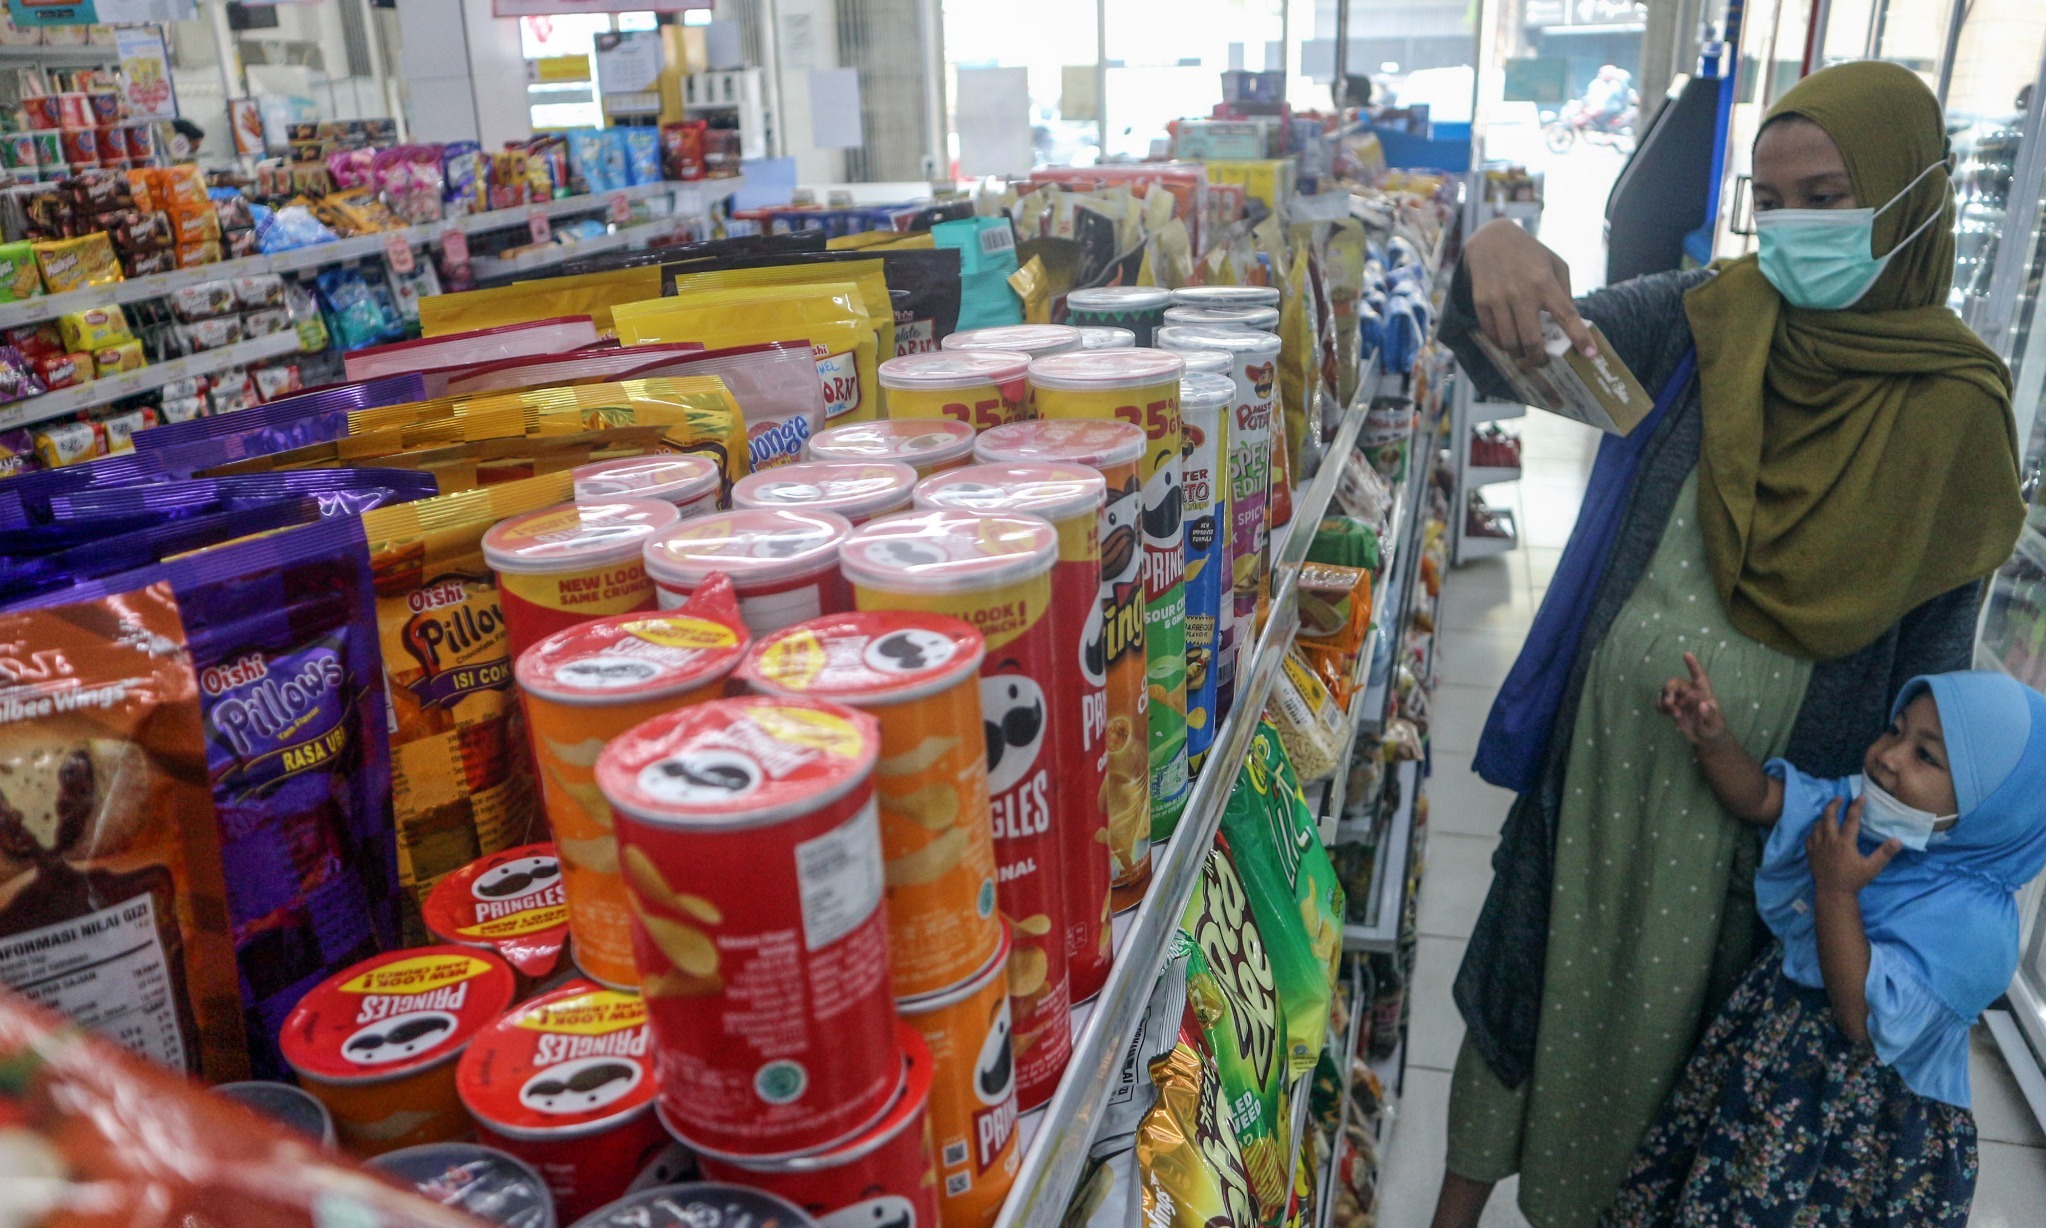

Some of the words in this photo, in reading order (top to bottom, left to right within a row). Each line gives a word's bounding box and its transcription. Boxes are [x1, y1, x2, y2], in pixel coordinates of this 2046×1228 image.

[1236, 404, 1271, 431] POTA
[1230, 440, 1268, 478] SPEC
[1182, 469, 1208, 482] TER
[1232, 471, 1266, 503] EDIT
[558, 575, 601, 594] NEW
[1143, 550, 1185, 593] PRING
[408, 582, 464, 613] Oishi
[561, 592, 599, 606] SAME
[602, 579, 650, 599] CRUNC
[202, 654, 267, 696] Oishi
[453, 671, 475, 690] ISI
[479, 664, 510, 684] COK
[213, 655, 344, 756] Pillows
[282, 741, 328, 772] RASA
[991, 768, 1049, 841] GLES
[1000, 857, 1036, 882] NAL
[123, 902, 148, 922] GIZI
[475, 885, 566, 923] PRINGLES
[377, 973, 425, 988] LOOK
[429, 968, 468, 982] NEW
[356, 982, 468, 1024] PRINGLES
[533, 1024, 649, 1066] PRINGLES
[1231, 1091, 1253, 1117] LED
